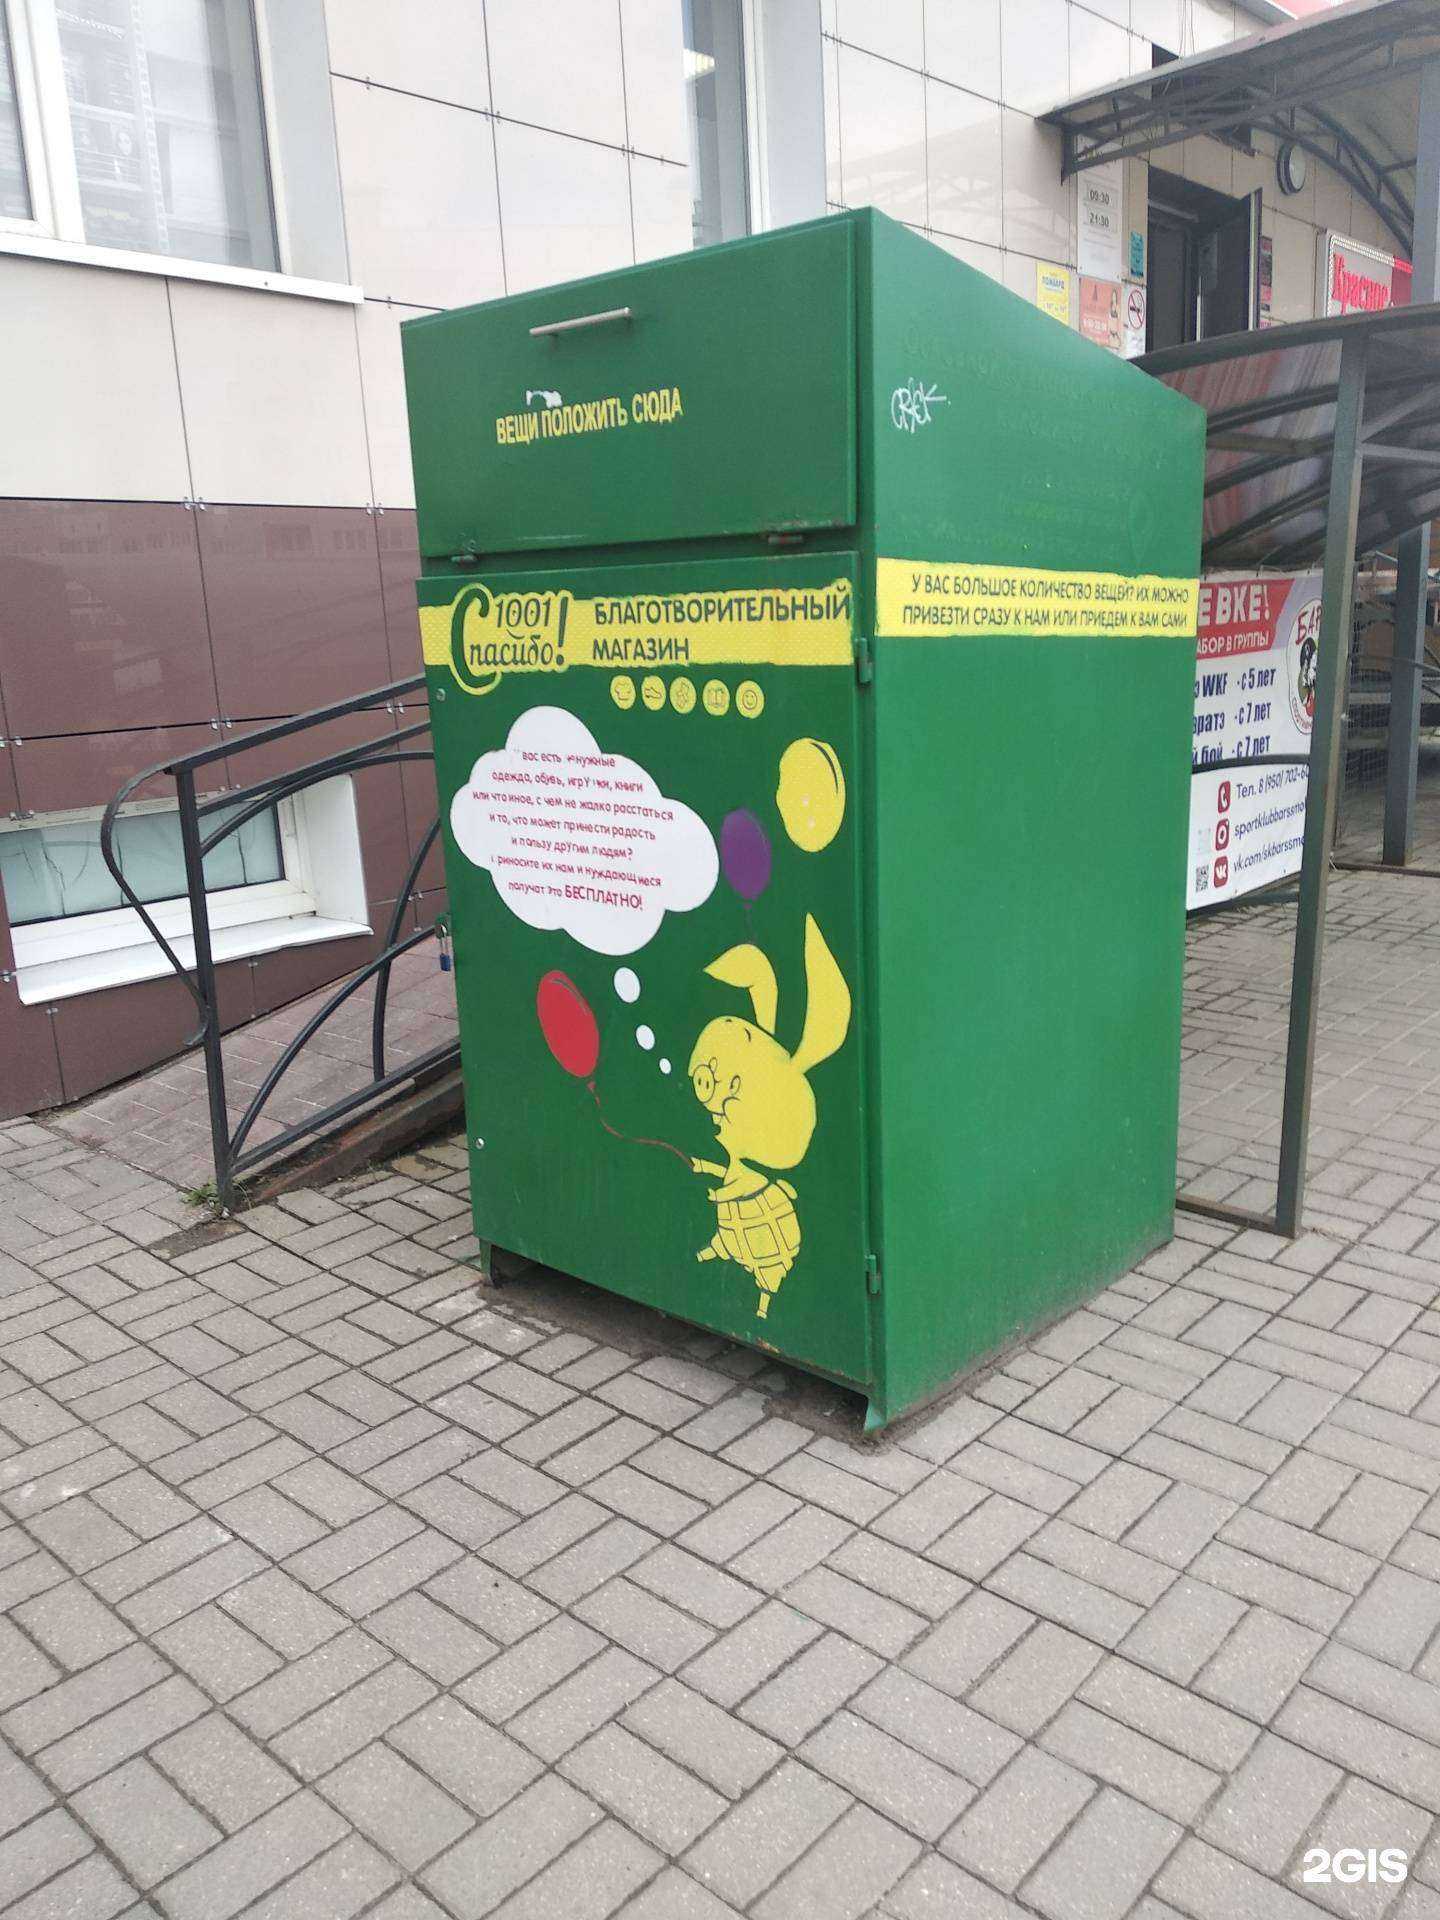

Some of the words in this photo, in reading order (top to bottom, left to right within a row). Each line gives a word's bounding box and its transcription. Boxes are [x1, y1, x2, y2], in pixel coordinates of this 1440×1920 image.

[496, 412, 539, 445] ВЕЩИ
[542, 397, 628, 439] ПОЛОЖИТЬ
[632, 387, 684, 424] СЮДА
[912, 574, 922, 594] У
[925, 575, 950, 595] ВАС
[953, 576, 1017, 597] БОЛЬШОЕ
[1020, 579, 1092, 600] КОЛИЧЕСТВО
[1136, 584, 1149, 602] ИХ
[1151, 586, 1189, 604] МОЖНО
[495, 597, 551, 629] 1001
[594, 585, 851, 627] БЛАГОТВОРИТЕЛЬНЫЙ
[903, 605, 970, 625] ПРИВЕЗТИ
[973, 606, 1011, 626] СРАЗУ
[1013, 607, 1022, 625] К
[1024, 607, 1051, 626] НАМ
[1053, 608, 1077, 627] ИЛИ
[1080, 609, 1128, 629] ПРИЕДЕМ
[1130, 611, 1137, 627] К
[1139, 611, 1160, 628] ВАМ
[1161, 612, 1187, 628] САМИ
[592, 636, 690, 661] МАГАЗИН
[1226, 635, 1232, 652] В
[1232, 630, 1269, 650] ГРУППЫ
[1202, 672, 1228, 698] WKF
[1248, 667, 1255, 690] 5
[1256, 668, 1277, 688] лет
[1247, 702, 1252, 723] 7
[1253, 702, 1272, 722] лет
[522, 752, 538, 761] вас
[541, 754, 562, 763] есть
[1201, 741, 1223, 763] бой
[1245, 735, 1251, 757] 7
[1252, 735, 1271, 755] лет
[491, 771, 533, 784] одежда,
[535, 772, 565, 787] обувь,
[568, 777, 613, 791] игруки,
[614, 781, 644, 792] книги
[1236, 783, 1257, 799] Тел.
[1258, 778, 1264, 794] 8
[472, 791, 489, 801] или
[491, 793, 507, 802] что
[509, 795, 534, 806] иное,
[536, 796, 542, 805] с
[544, 797, 563, 807] чем
[565, 799, 577, 809] не
[579, 801, 611, 812] жалко
[613, 803, 674, 821] расстаться
[489, 813, 496, 823] и
[497, 814, 511, 825] то,
[512, 816, 528, 826] что
[530, 818, 561, 830] может
[564, 821, 611, 835] принести
[611, 826, 656, 841] радость
[519, 838, 552, 851] пользу
[554, 842, 589, 854] другим
[592, 846, 633, 861] людям?
[491, 855, 539, 869] риносите
[541, 861, 553, 871] их
[555, 863, 575, 874] нам
[585, 866, 662, 887] нуждающиеся
[508, 881, 545, 895] получат
[547, 885, 563, 897] это
[564, 884, 644, 910] БЕСПЛАТНО!
